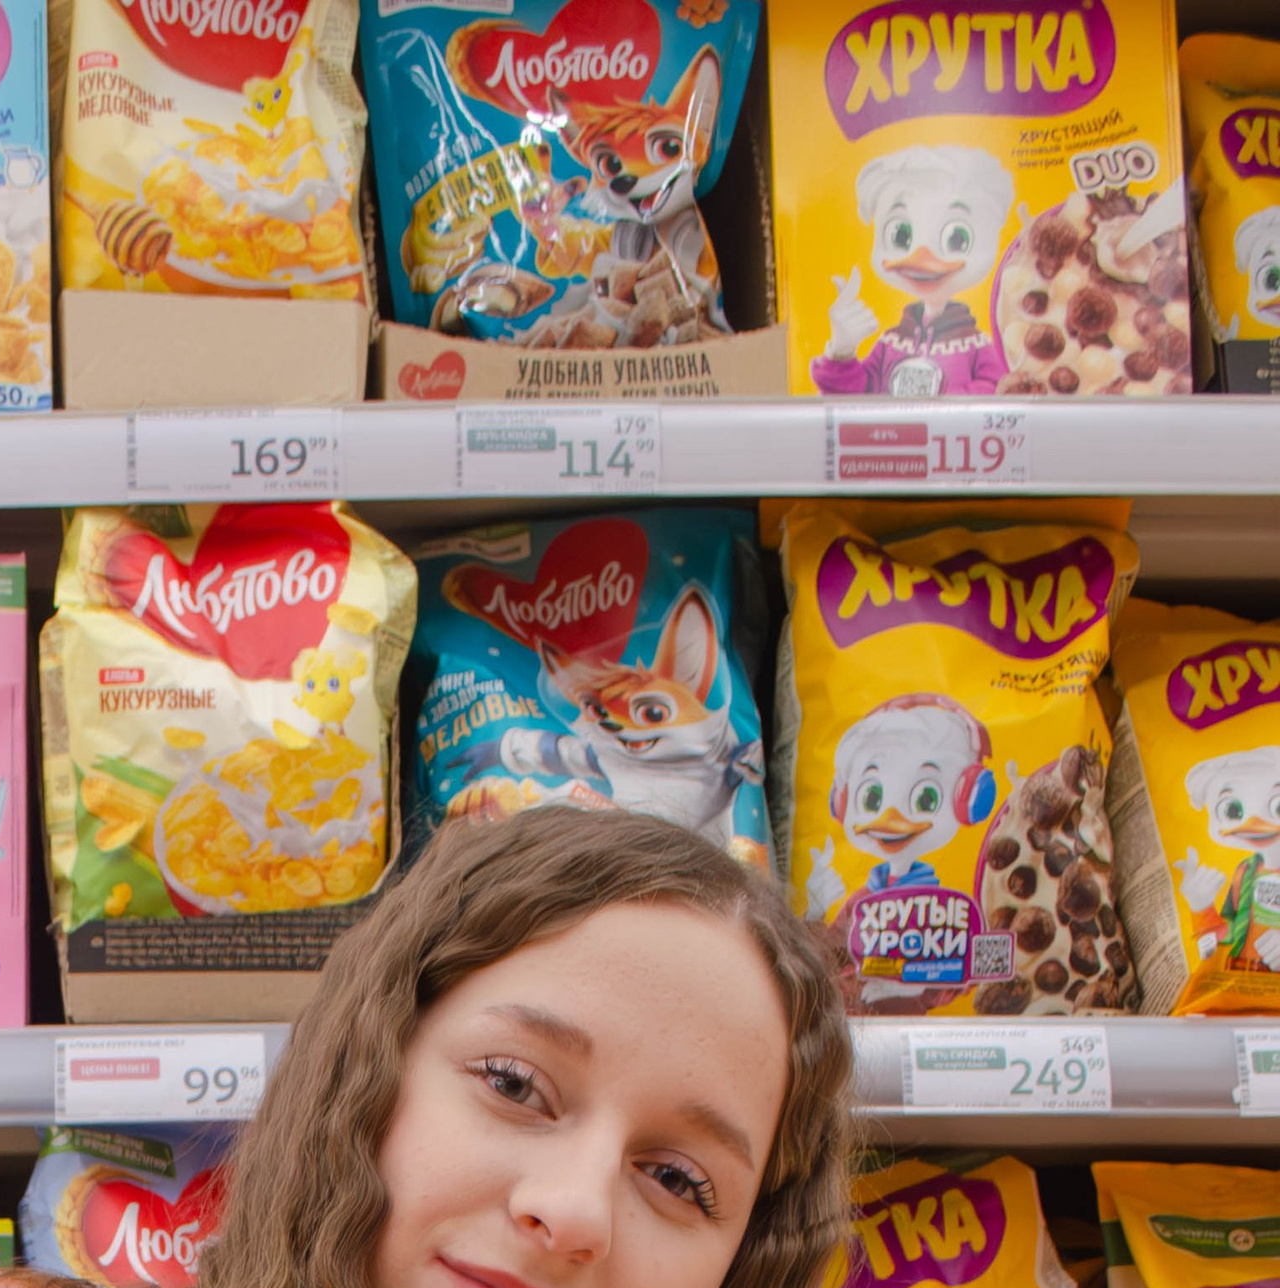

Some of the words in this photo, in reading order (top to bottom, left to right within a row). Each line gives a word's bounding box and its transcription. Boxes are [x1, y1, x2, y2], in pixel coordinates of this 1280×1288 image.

[485, 36, 649, 109] Любятово
[845, 12, 1097, 115] ХРУТКА
[78, 72, 175, 113] КУКУРУЗНЫЕ
[78, 99, 153, 127] МЕДОВЫЕ
[1020, 108, 1124, 145] ХРУСТЯЩИЙ
[1073, 146, 1156, 190] DUO
[517, 357, 603, 386] УДОБНАЯ
[614, 352, 712, 385] УПАКОВКА
[613, 416, 646, 436] 179
[983, 414, 1017, 430] 329
[230, 437, 308, 476] 169
[309, 437, 328, 450] 99
[558, 438, 635, 479] 114
[635, 438, 655, 453] 99
[932, 435, 1005, 474] 119
[1008, 435, 1025, 449] 97
[484, 561, 634, 639] Любятово
[838, 542, 1097, 643] ХРУТКА
[100, 688, 216, 713] КУКУРУЗНЫЕ
[860, 895, 969, 929] ХРУТЫЕ
[860, 928, 967, 958] УРОКИ
[1061, 1037, 1094, 1053] 349
[183, 1066, 239, 1104] 99
[241, 1066, 260, 1078] 96
[1010, 1059, 1088, 1095] 249
[1088, 1059, 1105, 1071] 99
